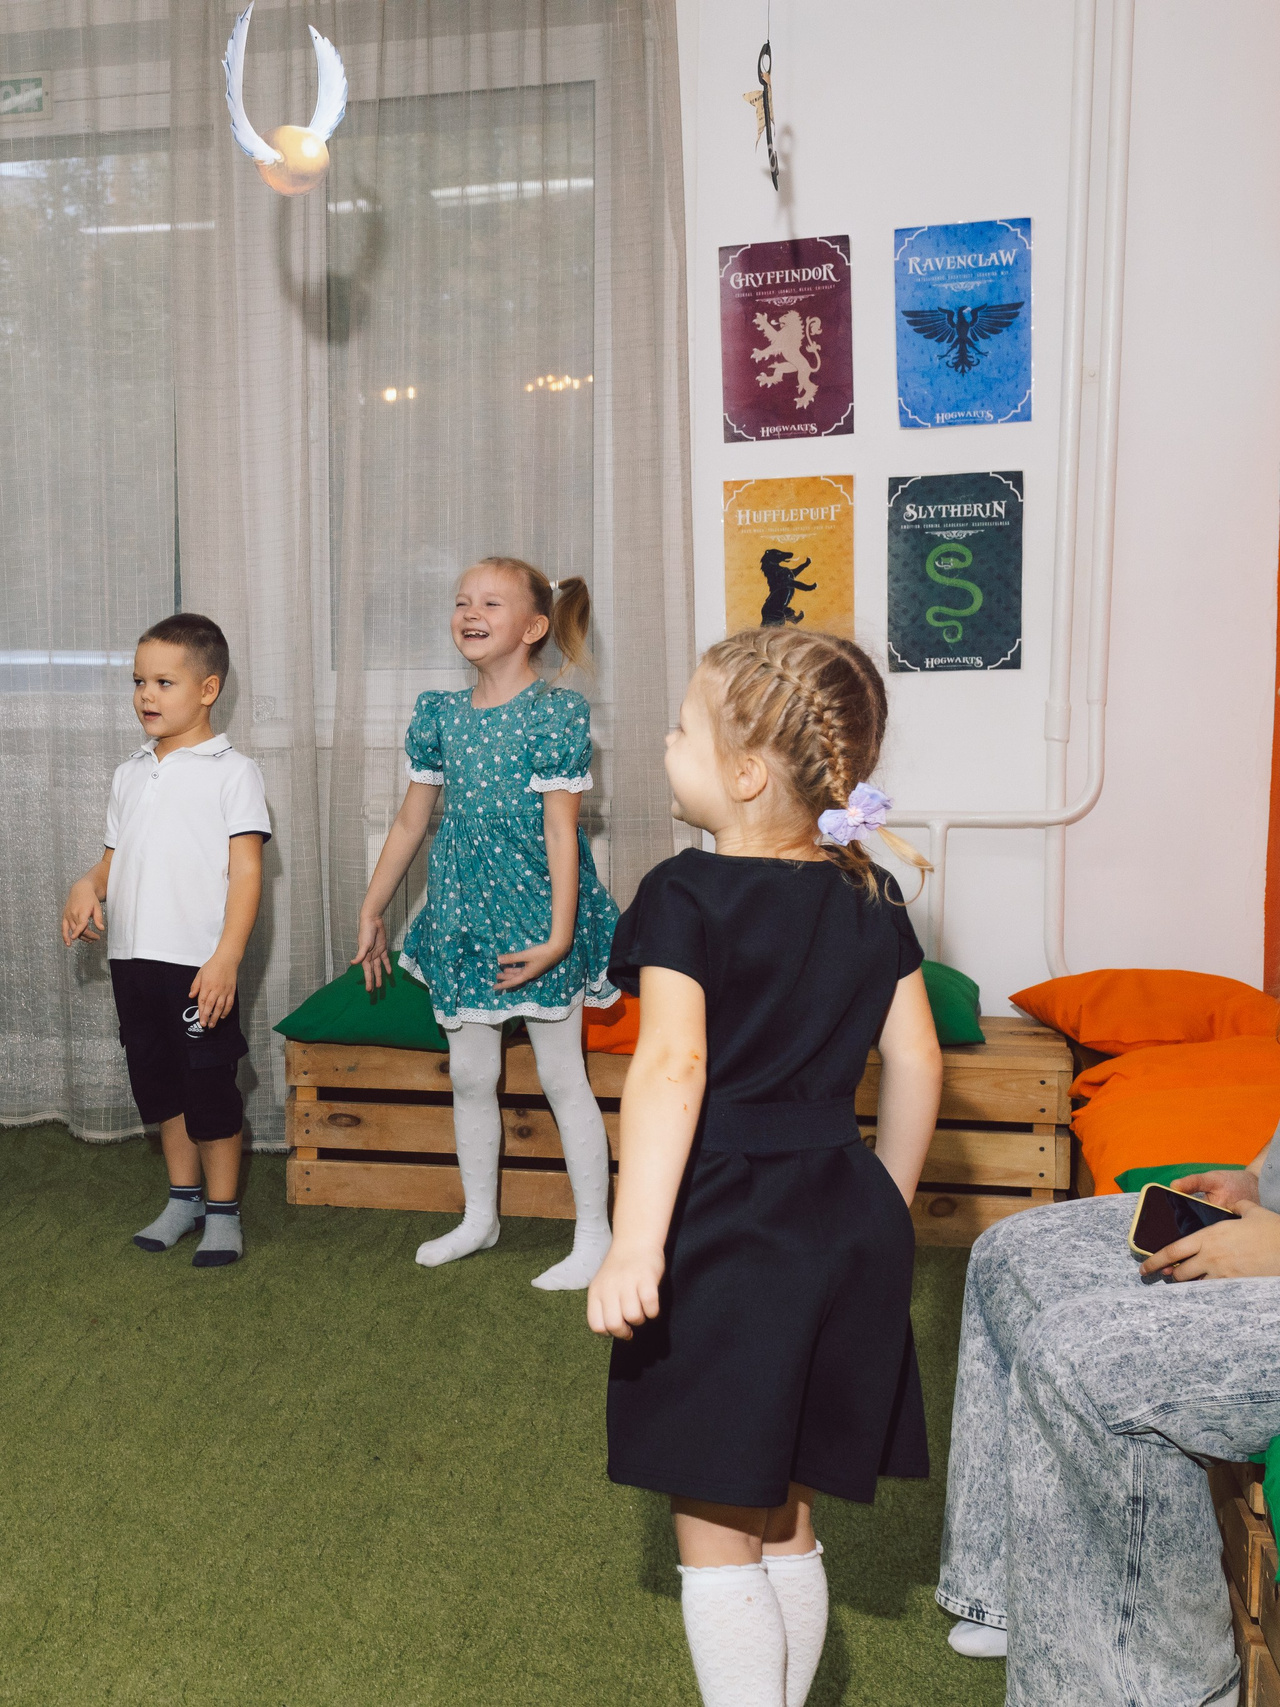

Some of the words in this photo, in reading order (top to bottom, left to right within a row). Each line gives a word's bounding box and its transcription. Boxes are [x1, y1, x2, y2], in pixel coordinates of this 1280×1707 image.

[908, 248, 1019, 276] RAVENCLAW
[729, 263, 841, 290] GRYFFINDOR
[934, 409, 994, 424] HOGWARTS
[759, 422, 818, 438] HOGWARTS
[736, 504, 841, 526] HUFFLEPUFF
[903, 500, 1008, 522] SLYTHERIN
[923, 656, 984, 669] HOGWARTS
